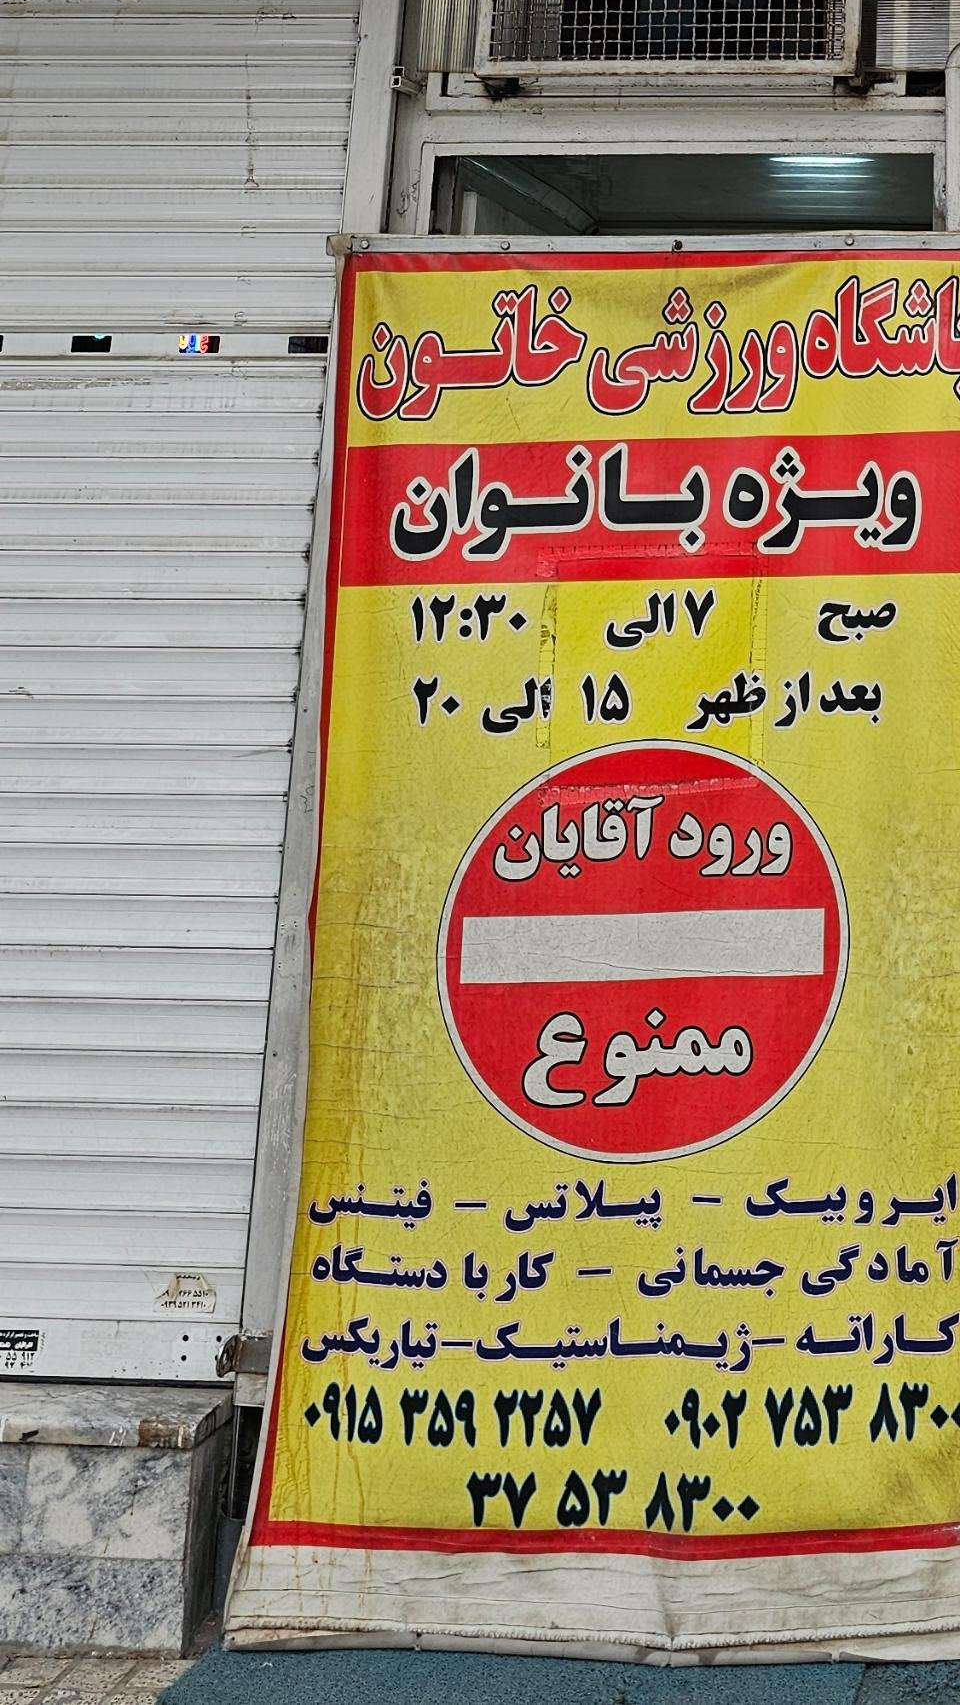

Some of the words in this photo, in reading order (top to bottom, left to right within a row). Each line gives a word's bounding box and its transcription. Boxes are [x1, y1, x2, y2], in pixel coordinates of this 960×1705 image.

[357, 284, 588, 421] خاتون
[587, 287, 800, 416] ورزشی
[390, 442, 708, 562] بانوان
[726, 444, 922, 555] ویژه
[411, 594, 528, 643] ۱۲:۳۰
[604, 590, 680, 650] الی
[682, 588, 717, 638] ۷
[816, 599, 898, 643] صبح
[413, 676, 462, 726] ۲۰
[481, 676, 552, 735] الی
[581, 671, 632, 725] ۱۵
[685, 671, 768, 732] ظهر
[493, 796, 665, 882] آقایان
[668, 812, 793, 877] ورود
[522, 1007, 753, 1108] ممنوع
[308, 1179, 433, 1231] فیتنس
[503, 1179, 662, 1233] پیلاتس
[311, 1242, 447, 1290] دستگاه
[462, 1250, 488, 1301] با
[494, 1249, 555, 1303] کار
[636, 1245, 786, 1298] جسمانی
[801, 1237, 960, 1298] آمادگی
[475, 1316, 752, 1373] ژیمناستیک
[795, 1311, 960, 1367] کاراته
[304, 1381, 383, 1445] ۰۹۱۵
[400, 1387, 477, 1448] ۳۵۹
[494, 1387, 601, 1448] ۲۲۵۷
[664, 1387, 748, 1449] ۰۹۰۲
[766, 1384, 853, 1448] ۷۵۳
[466, 1470, 537, 1530] ۳۷
[555, 1469, 627, 1528] ۵۳
[645, 1471, 760, 1534] ۸۳۰۰
